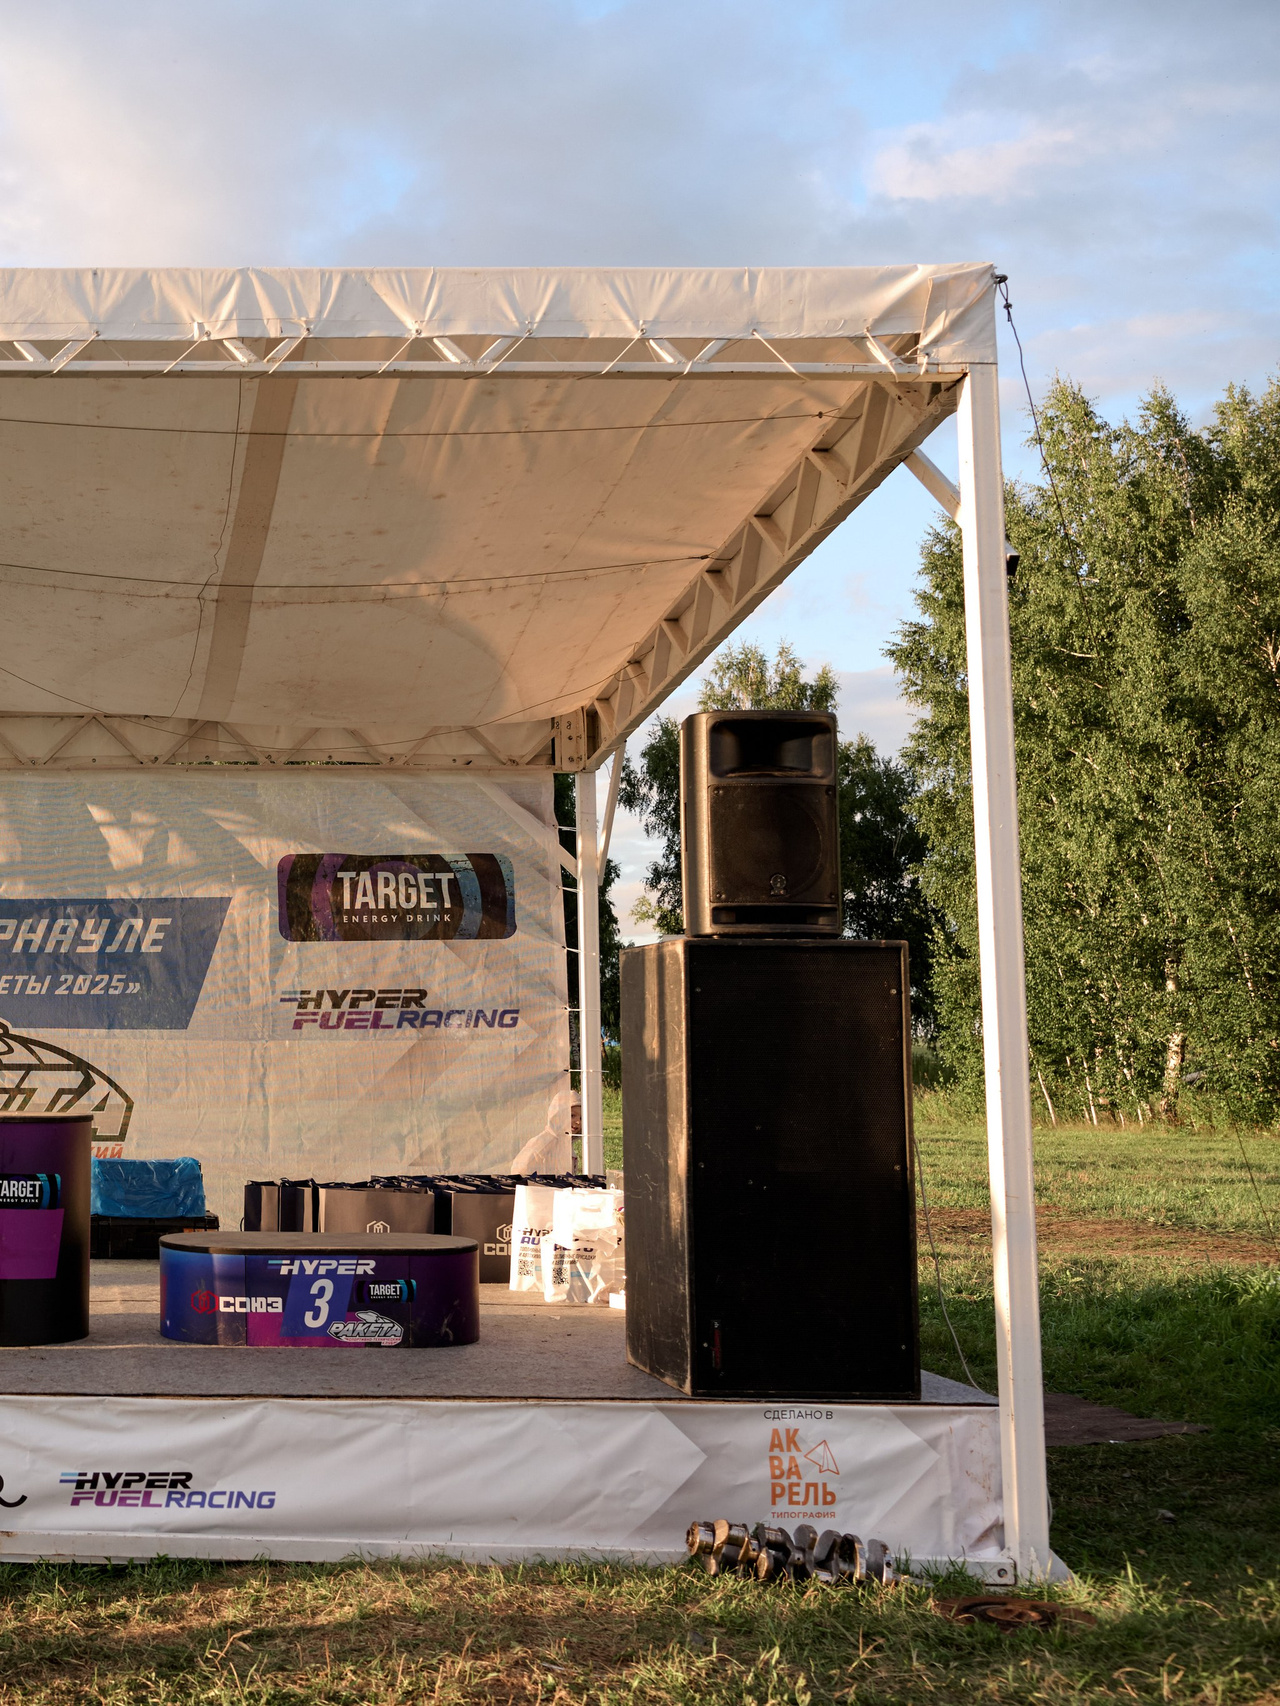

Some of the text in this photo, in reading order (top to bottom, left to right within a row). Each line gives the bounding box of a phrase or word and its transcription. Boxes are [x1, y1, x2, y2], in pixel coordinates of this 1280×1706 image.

[337, 871, 455, 910] TARGET
[343, 913, 452, 923] ENERGY DRINK
[55, 974, 141, 995] 2025»
[296, 989, 428, 1009] HYPER
[522, 1227, 553, 1237] HYP
[520, 1236, 541, 1246] AU
[483, 1243, 512, 1256] СО
[280, 1259, 376, 1275] HYPER
[369, 1284, 401, 1296] TARGET
[219, 1296, 283, 1312] СОЮЗ
[304, 1279, 334, 1328] 3
[329, 1322, 402, 1337] РАКЕТА
[763, 1410, 834, 1421] СДЕЛАНО В
[769, 1428, 802, 1452] АК
[768, 1455, 803, 1480] ВА
[75, 1471, 193, 1490] HYPER
[771, 1482, 837, 1506] РЕЛЬ
[771, 1511, 837, 1519] ТИПОГРАФИЯ
